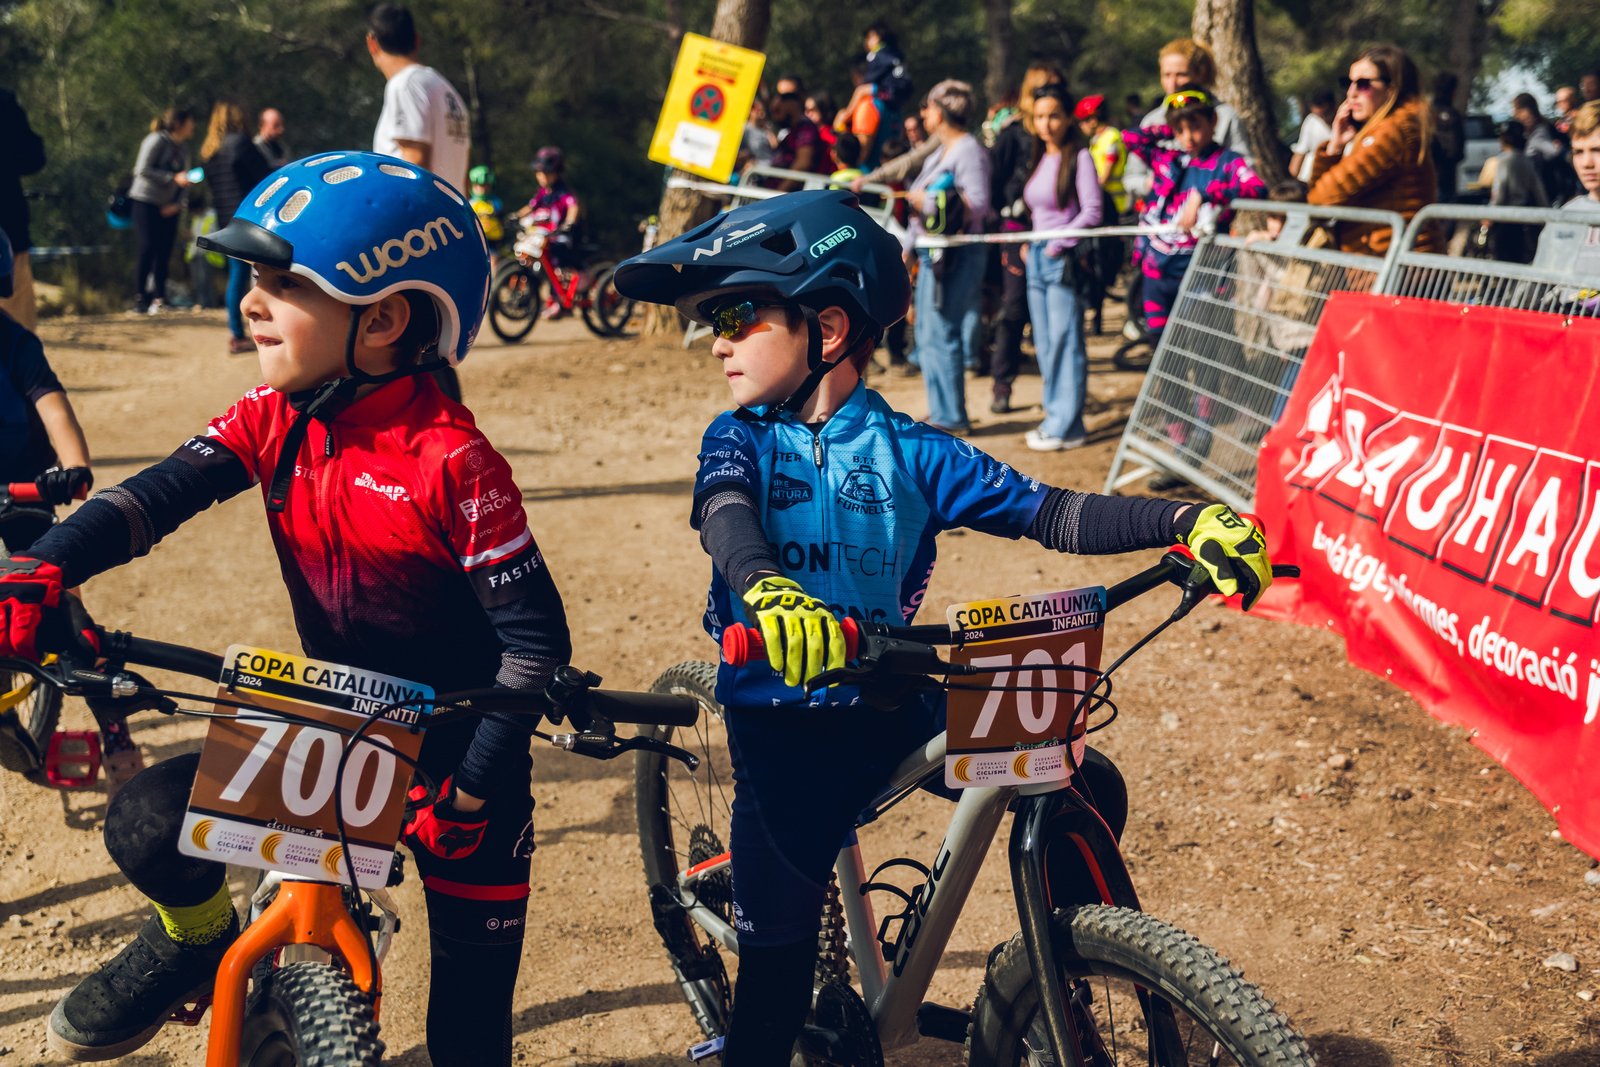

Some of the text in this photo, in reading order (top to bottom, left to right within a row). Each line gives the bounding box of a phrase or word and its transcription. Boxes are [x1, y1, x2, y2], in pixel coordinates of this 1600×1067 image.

[336, 216, 464, 284] woom
[817, 228, 852, 255] ABUS
[836, 497, 896, 515] FORNELLS
[760, 593, 815, 609] FOX
[955, 592, 1102, 628] COPA CATALUNYA
[964, 631, 984, 640] 2024
[1467, 615, 1578, 701] decoració
[235, 651, 426, 703] COPA CATALUNYA
[236, 673, 263, 688] 2024
[969, 641, 1086, 739] 701
[218, 707, 397, 829] 700
[1034, 764, 1062, 772] CICLISME
[217, 840, 253, 852] CICLISME
[285, 853, 319, 865] CICLISME
[353, 860, 382, 869] ATALANA
[353, 866, 380, 876] ICLISME
